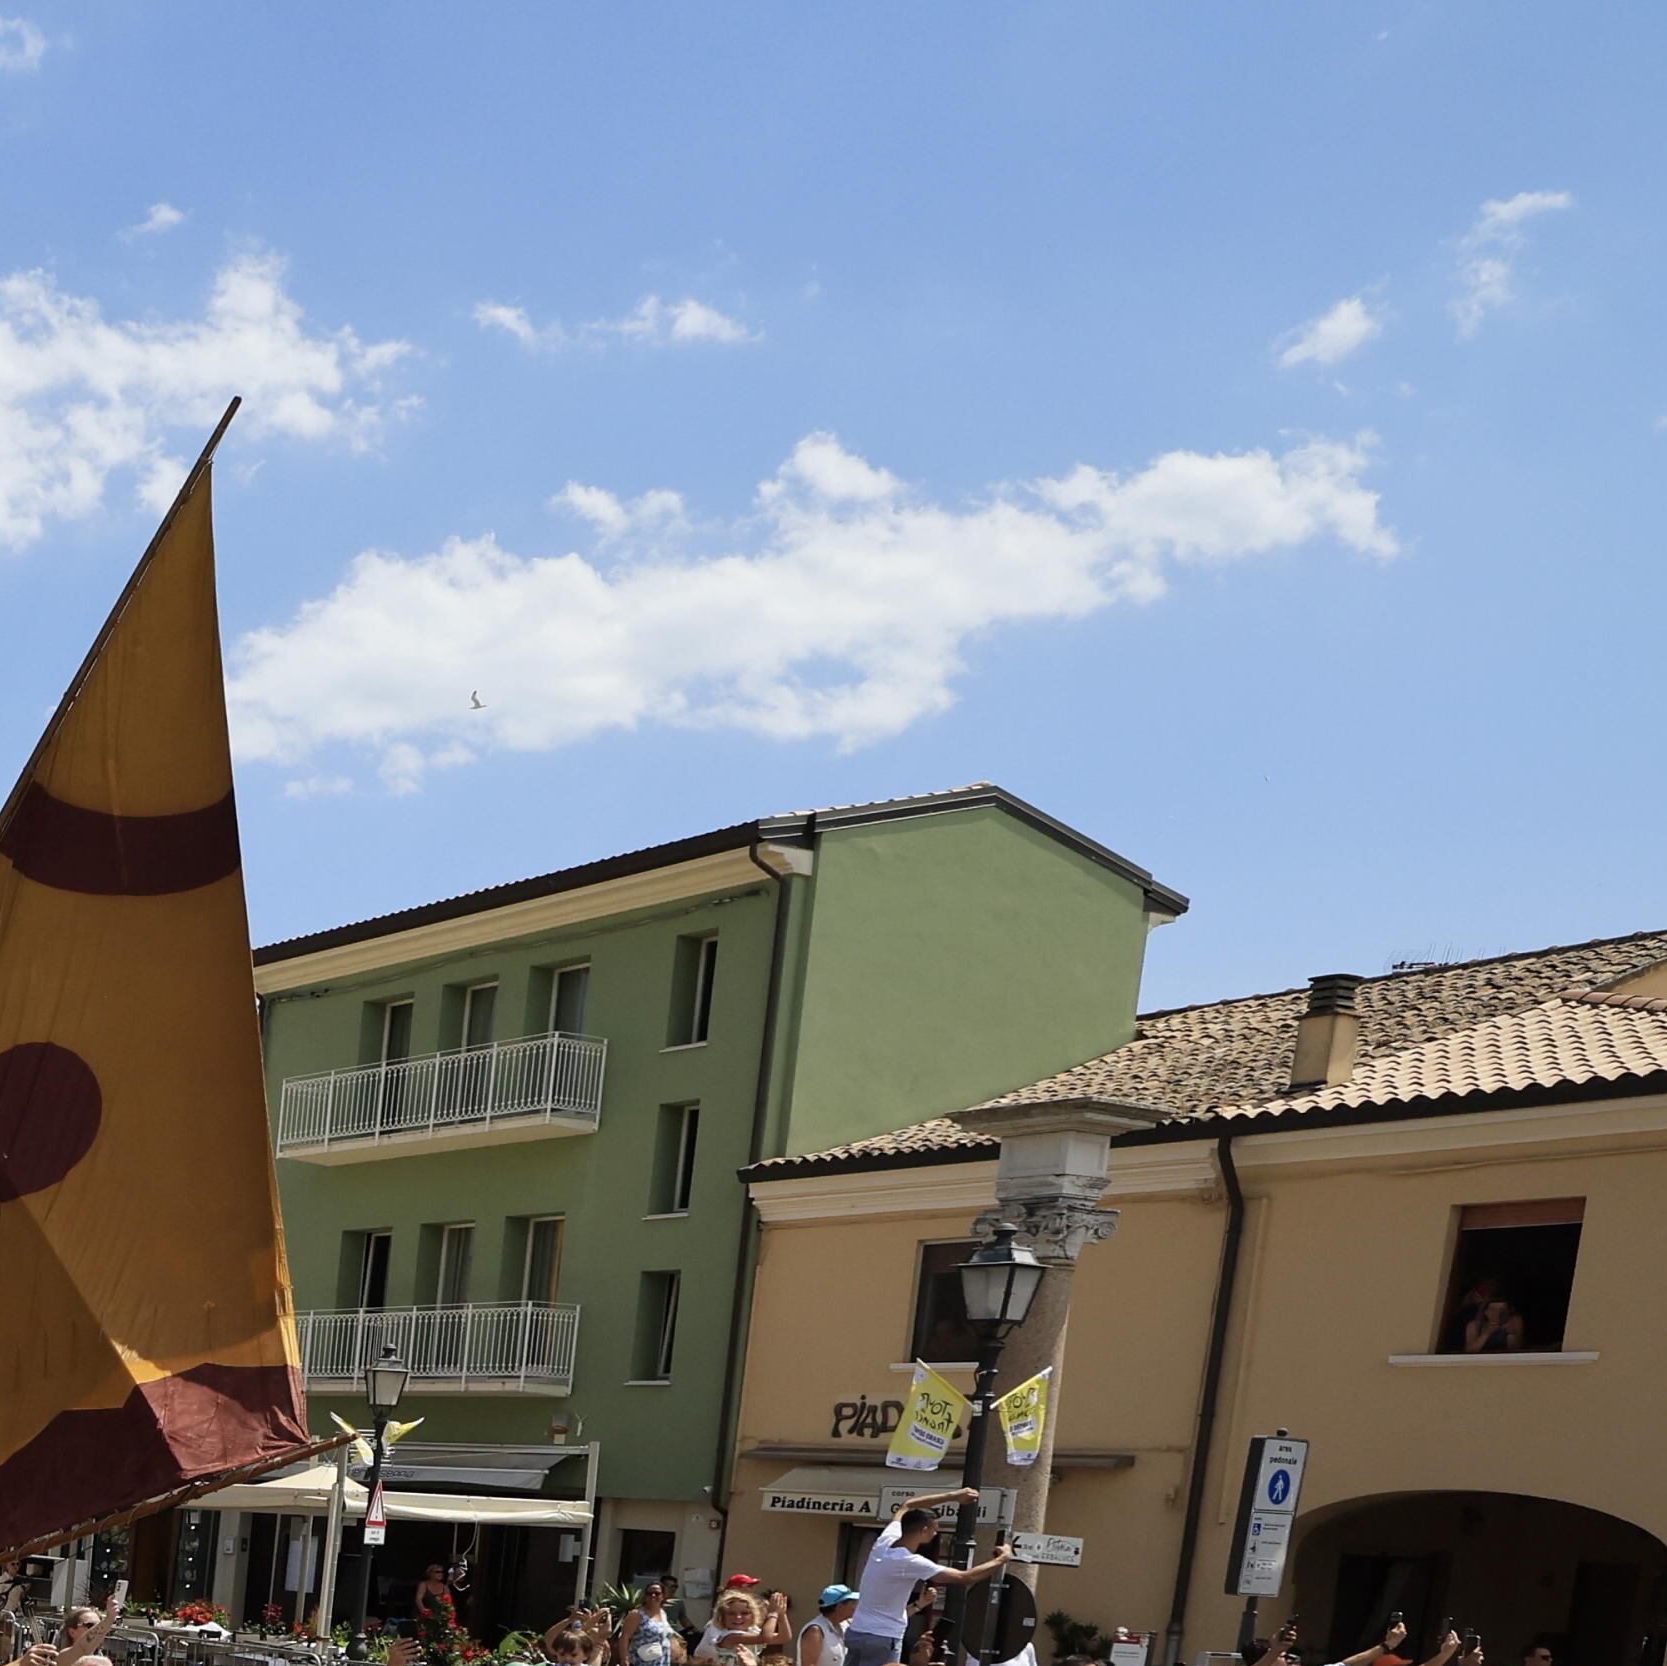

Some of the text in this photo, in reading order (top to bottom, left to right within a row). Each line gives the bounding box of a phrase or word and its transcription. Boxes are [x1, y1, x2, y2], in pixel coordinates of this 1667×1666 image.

[1278, 1445, 1292, 1453] area
[1269, 1456, 1297, 1466] pedonale
[770, 1496, 855, 1512] Piadineria
